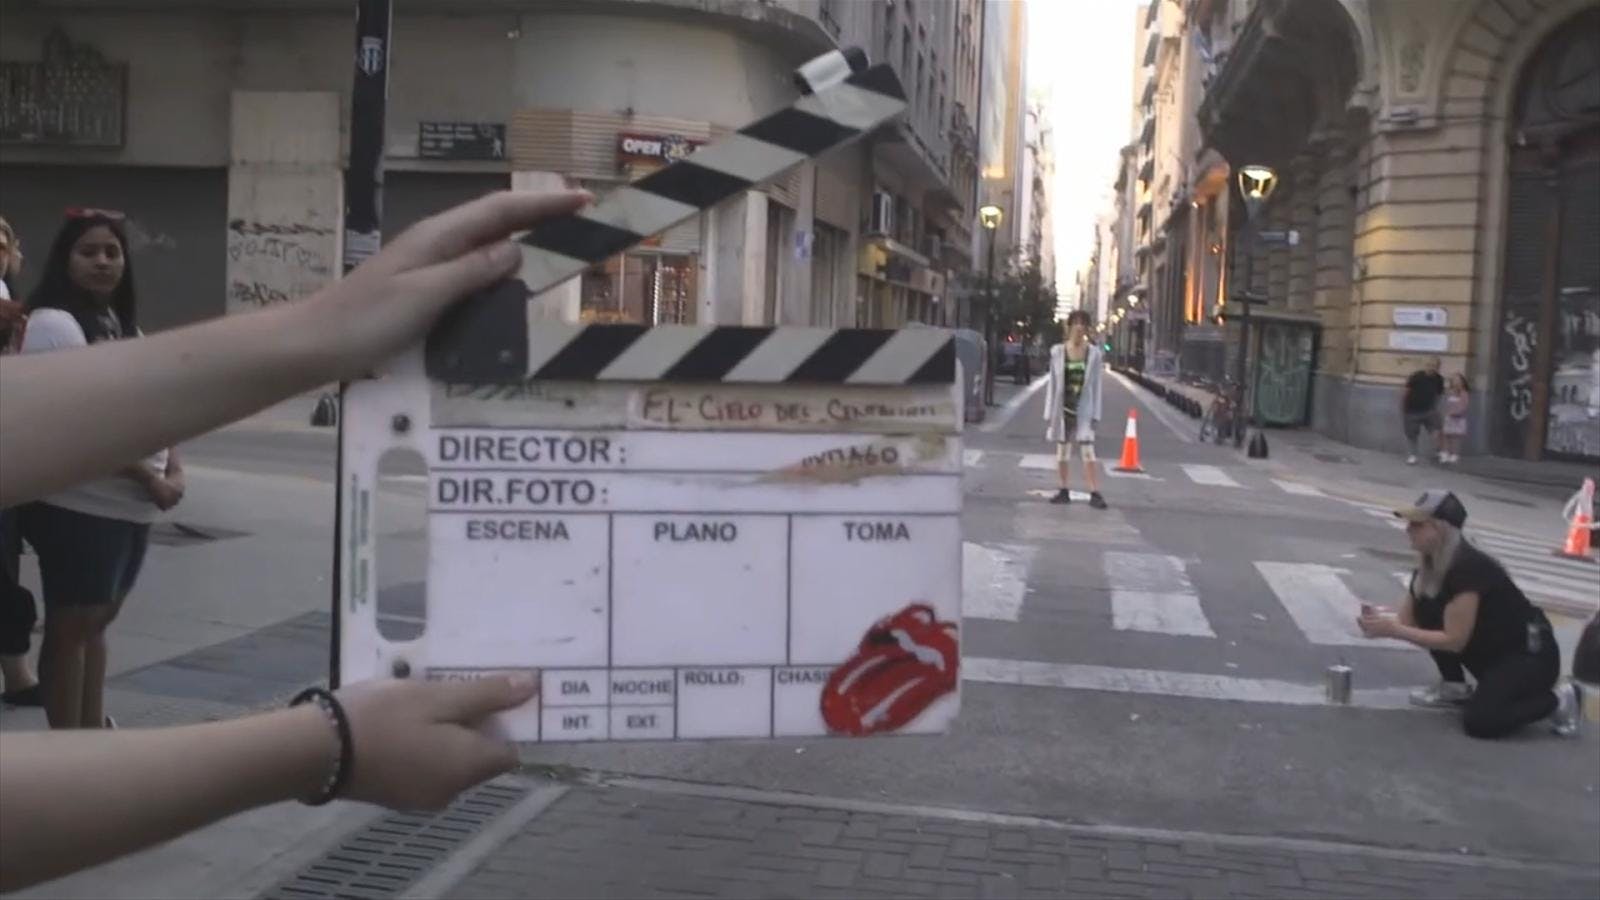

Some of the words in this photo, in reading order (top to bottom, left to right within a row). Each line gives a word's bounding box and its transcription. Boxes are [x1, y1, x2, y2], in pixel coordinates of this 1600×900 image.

[623, 138, 662, 155] OPEN
[465, 520, 570, 542] ESCENA
[653, 521, 737, 543] PLANO
[843, 521, 911, 542] TOMA
[561, 680, 591, 696] DIA
[612, 680, 672, 696] NOCHE
